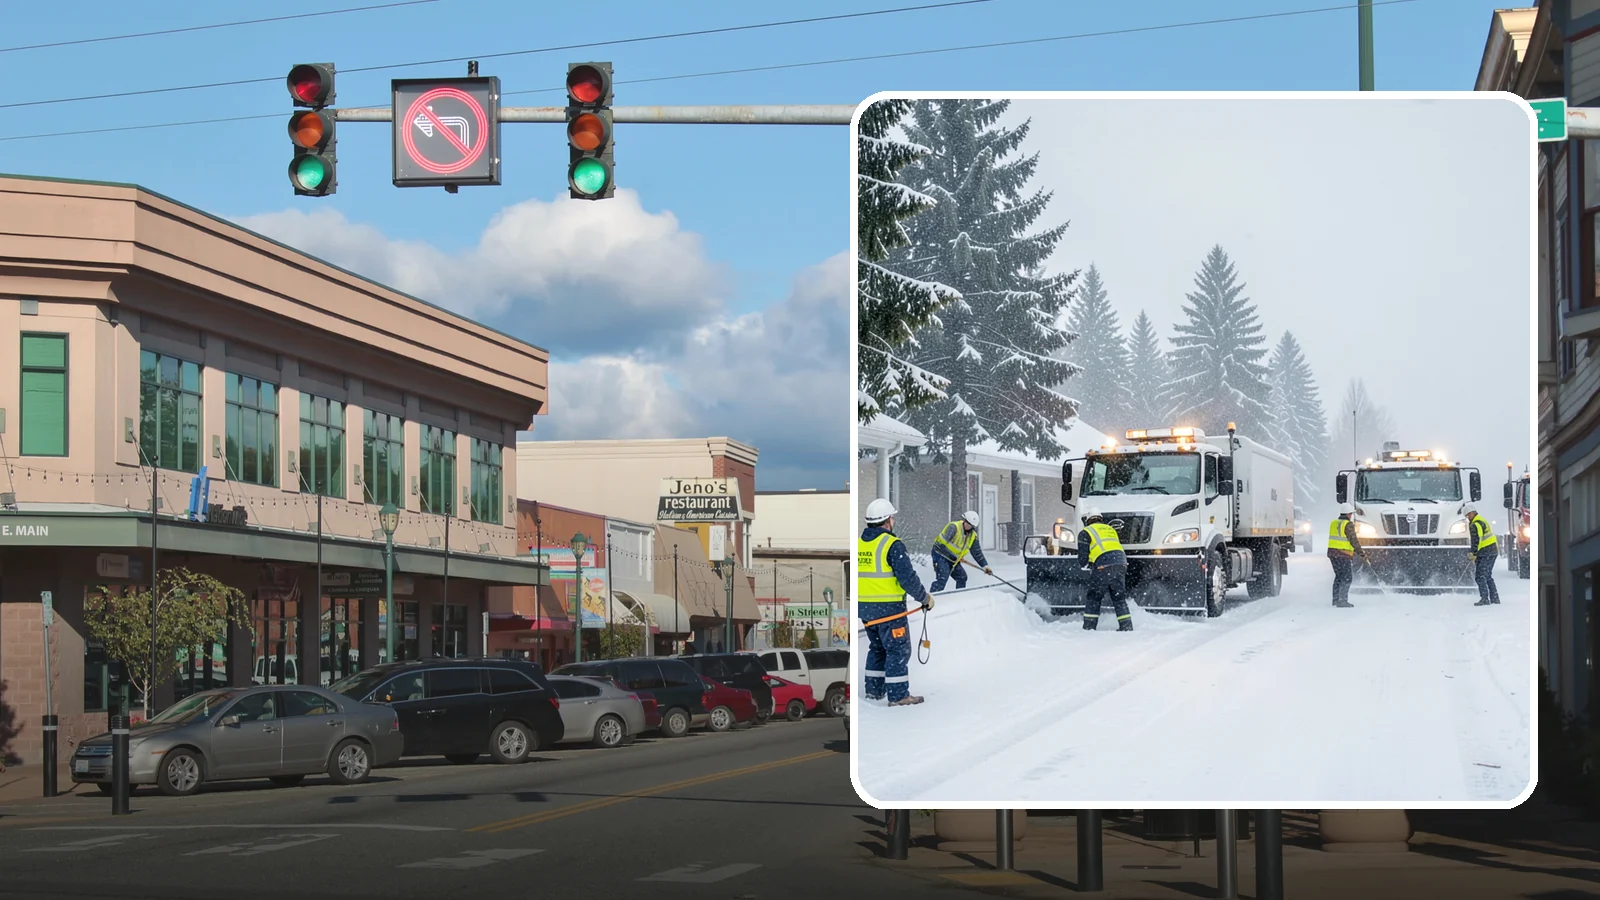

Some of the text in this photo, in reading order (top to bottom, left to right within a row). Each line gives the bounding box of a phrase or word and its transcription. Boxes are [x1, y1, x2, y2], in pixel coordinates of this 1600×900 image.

[670, 480, 728, 495] Jeno's
[665, 496, 731, 509] restaurant
[658, 509, 681, 520] Italian
[686, 509, 714, 520] American
[715, 509, 738, 520] Cuisine
[2, 525, 49, 537] E. MAIN
[797, 607, 828, 617] Street
[788, 619, 824, 627] lass
